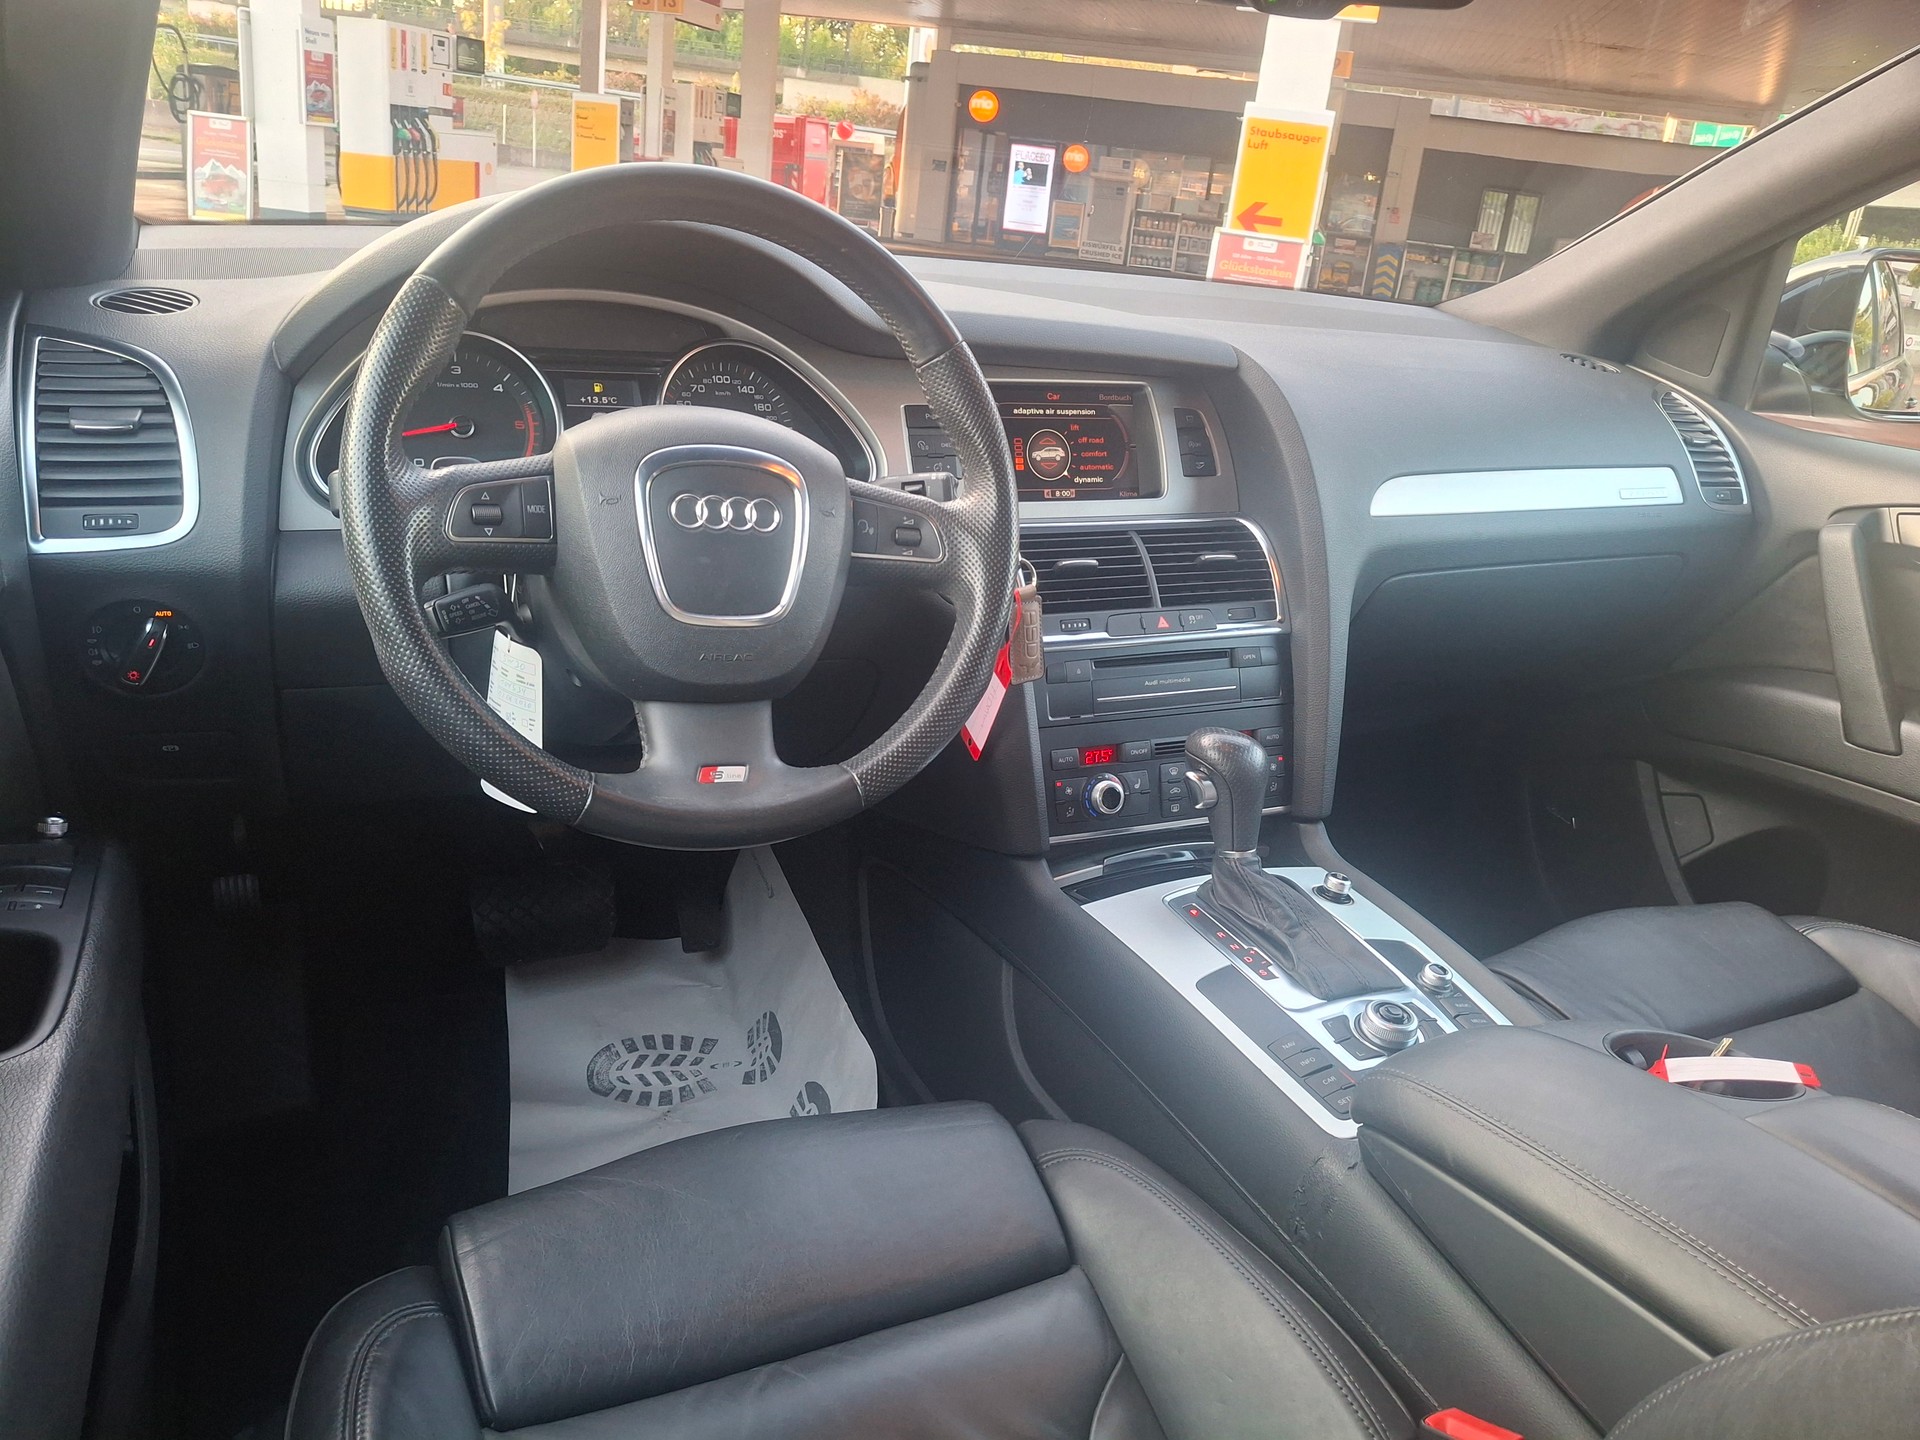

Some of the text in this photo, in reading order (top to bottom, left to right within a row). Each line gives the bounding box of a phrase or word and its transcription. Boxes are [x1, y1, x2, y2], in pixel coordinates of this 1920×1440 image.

[1250, 126, 1323, 145] Staubsauger
[1247, 138, 1269, 150] Luft
[1219, 259, 1293, 279] Glückstanken
[451, 366, 461, 374] 3
[712, 376, 730, 384] 100
[493, 384, 504, 392] 4
[690, 384, 706, 392] 70
[738, 386, 754, 394] 140
[754, 404, 772, 412] 180
[515, 420, 524, 429] 5
[414, 458, 424, 466] 0
[1074, 476, 1104, 484] dynamic
[527, 504, 546, 514] MODE
[699, 653, 754, 662] AIRBAG
[1282, 1041, 1296, 1050] NAV
[1300, 1056, 1316, 1066] INFO
[1322, 1076, 1336, 1085] CAR
